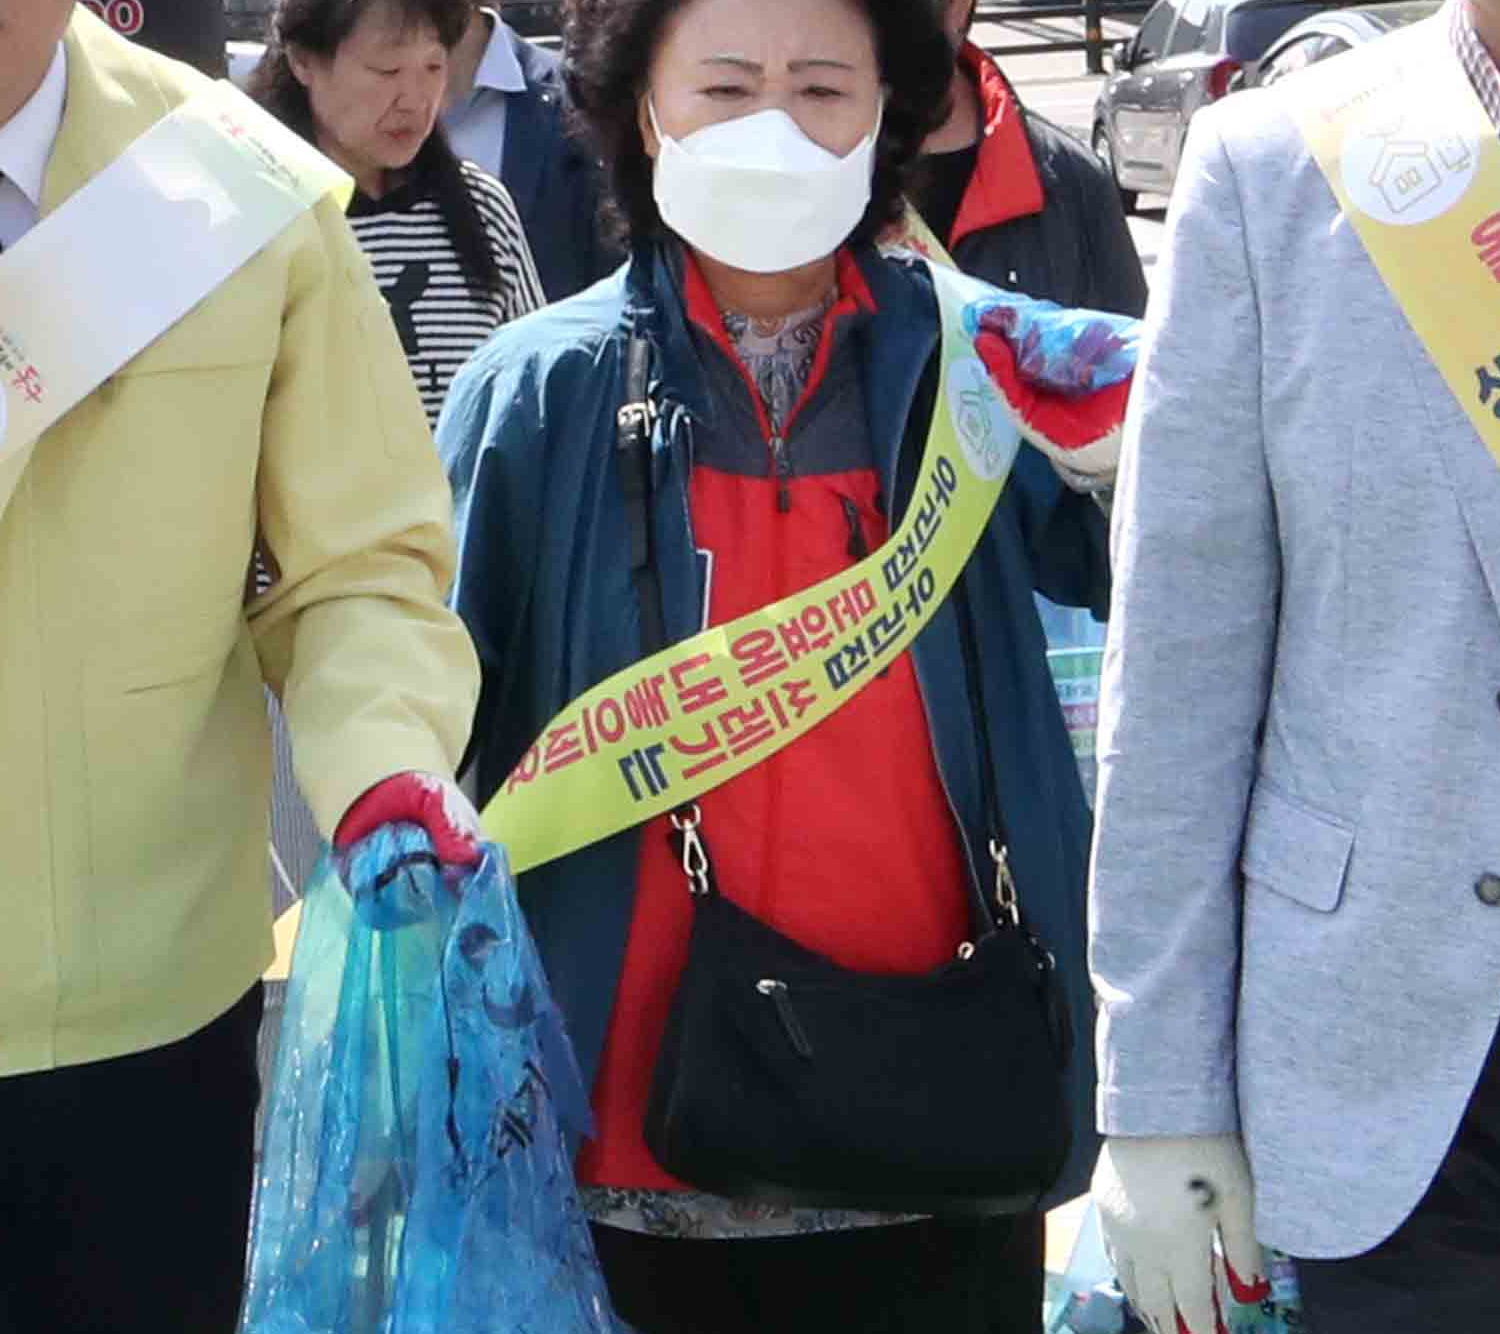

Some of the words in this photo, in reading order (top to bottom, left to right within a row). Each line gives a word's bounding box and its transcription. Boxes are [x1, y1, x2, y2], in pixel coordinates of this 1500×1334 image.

[881, 454, 957, 593] 우리집
[729, 578, 879, 688] 문앞에
[823, 566, 936, 691] 우리집
[617, 675, 817, 802] 쓰레기는
